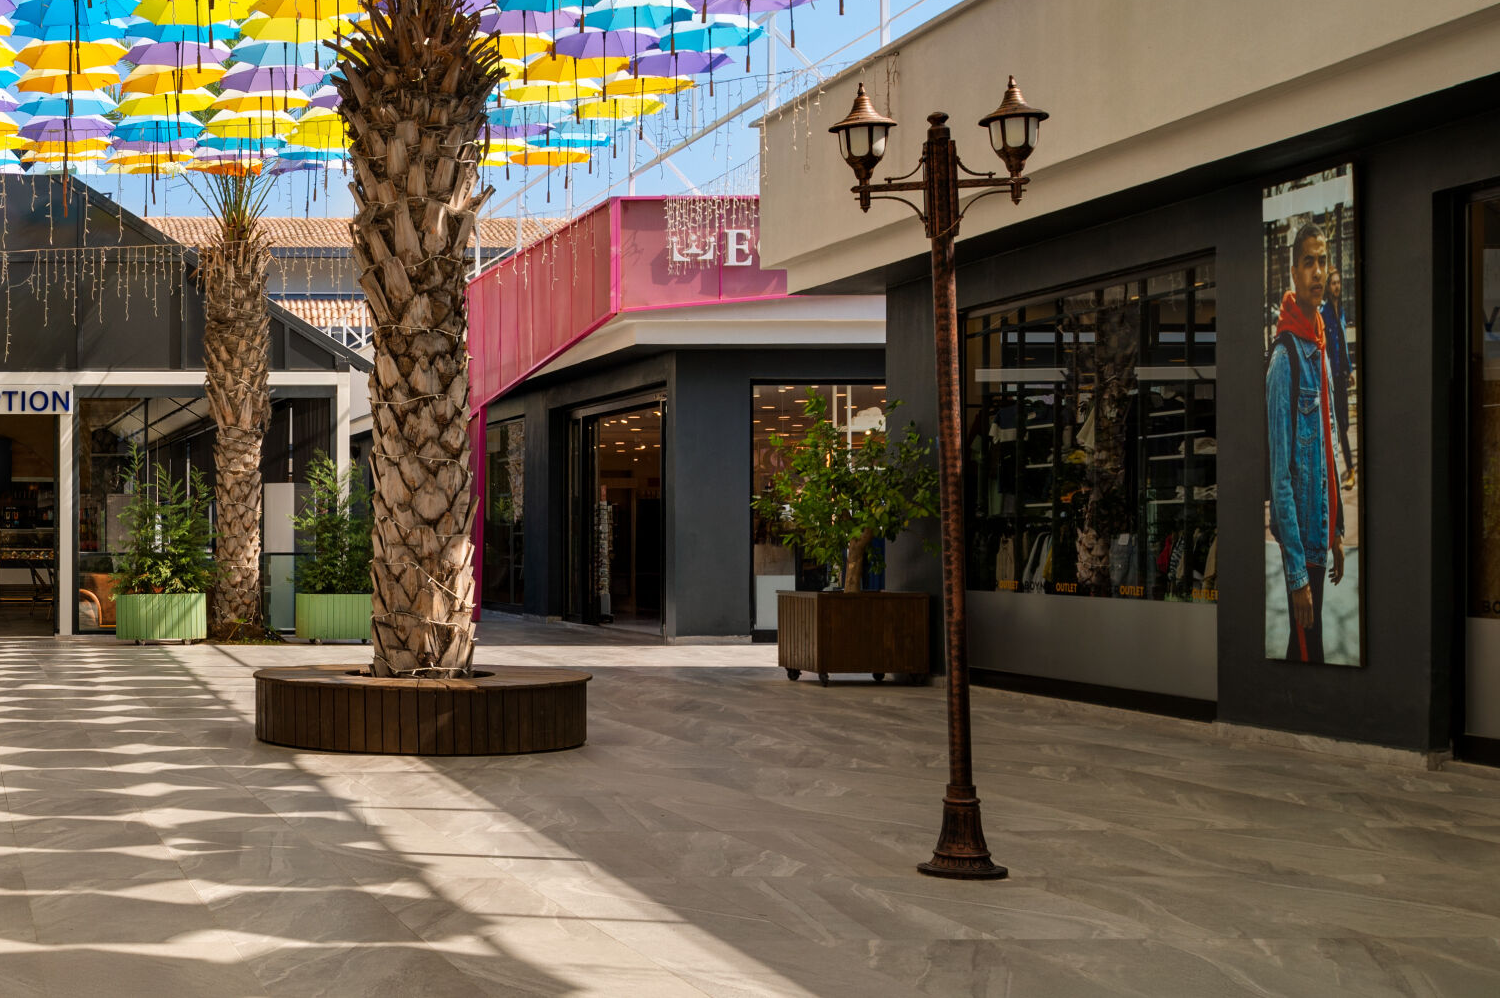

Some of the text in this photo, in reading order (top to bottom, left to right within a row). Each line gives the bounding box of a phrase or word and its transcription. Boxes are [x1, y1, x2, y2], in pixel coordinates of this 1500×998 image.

[723, 229, 760, 266] E
[1024, 580, 1052, 591] BOYN
[1055, 582, 1078, 593] OUTLET
[1119, 585, 1145, 597] OUTLET
[1192, 588, 1219, 601] OUTLET
